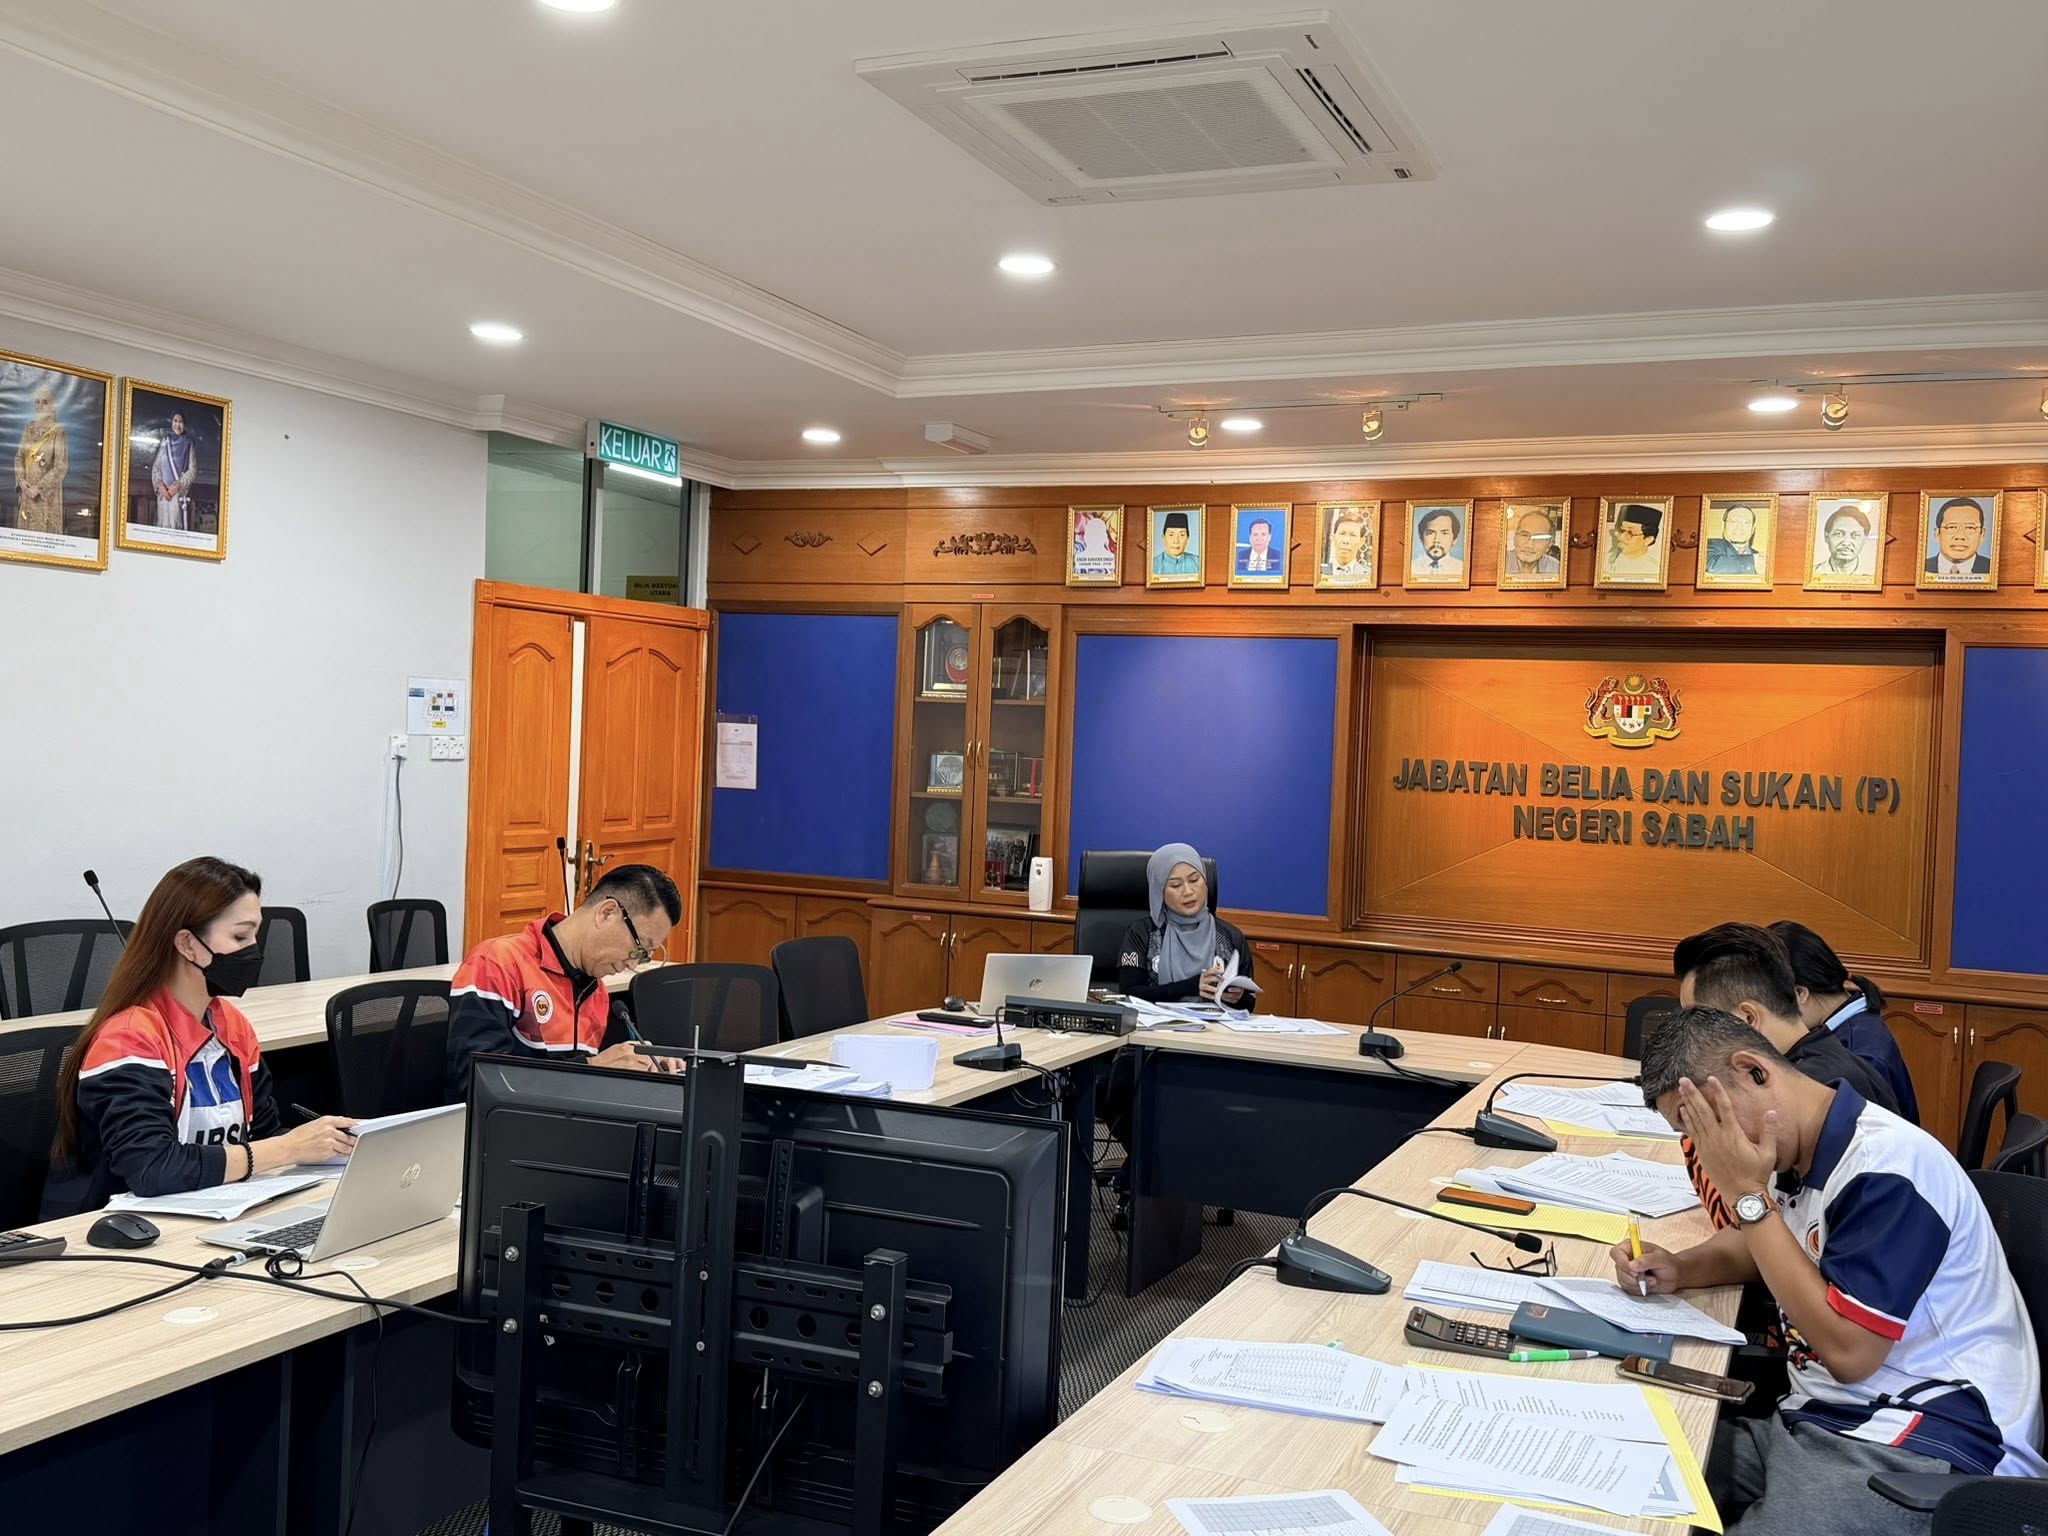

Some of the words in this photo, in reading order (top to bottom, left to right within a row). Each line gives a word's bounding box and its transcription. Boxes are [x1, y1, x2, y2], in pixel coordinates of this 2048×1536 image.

[601, 425, 662, 469] KELUAR
[1393, 758, 1527, 797] JABATAN
[1540, 763, 1635, 802] BELIA
[1642, 768, 1710, 806] DAN
[1721, 771, 1843, 812] SUKAN
[1855, 775, 1901, 814] (P)
[1513, 805, 1632, 845] NEGERI
[1641, 811, 1756, 851] SABAH
